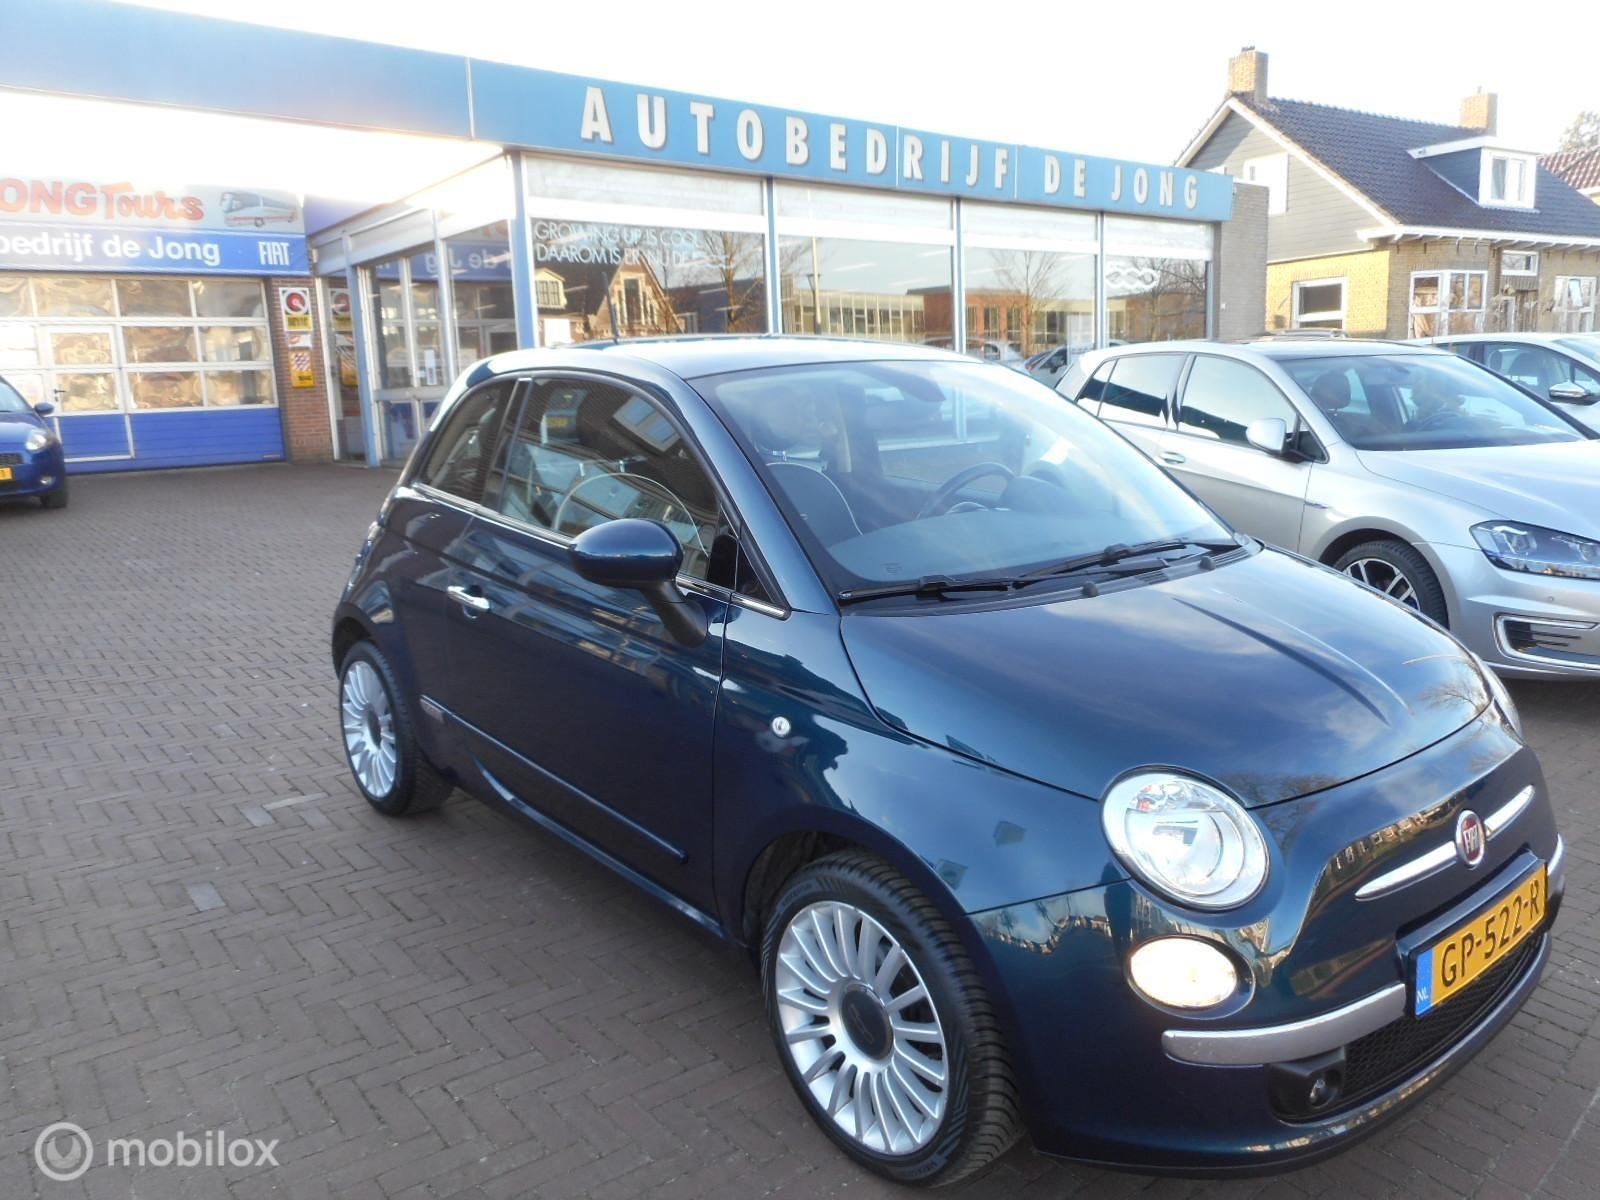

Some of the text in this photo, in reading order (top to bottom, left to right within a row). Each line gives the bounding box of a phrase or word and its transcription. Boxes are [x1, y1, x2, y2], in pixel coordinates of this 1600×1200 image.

[580, 86, 1199, 209] AUTOBEDRIJF DE JONG
[535, 221, 620, 242] GROWING
[102, 234, 140, 259] de
[149, 236, 221, 266] Jong
[259, 241, 292, 266] FIAT
[536, 244, 607, 265] DAAROM
[610, 247, 621, 264] IS
[1441, 880, 1539, 988] GP-522-R
[1417, 986, 1429, 1004] NL
